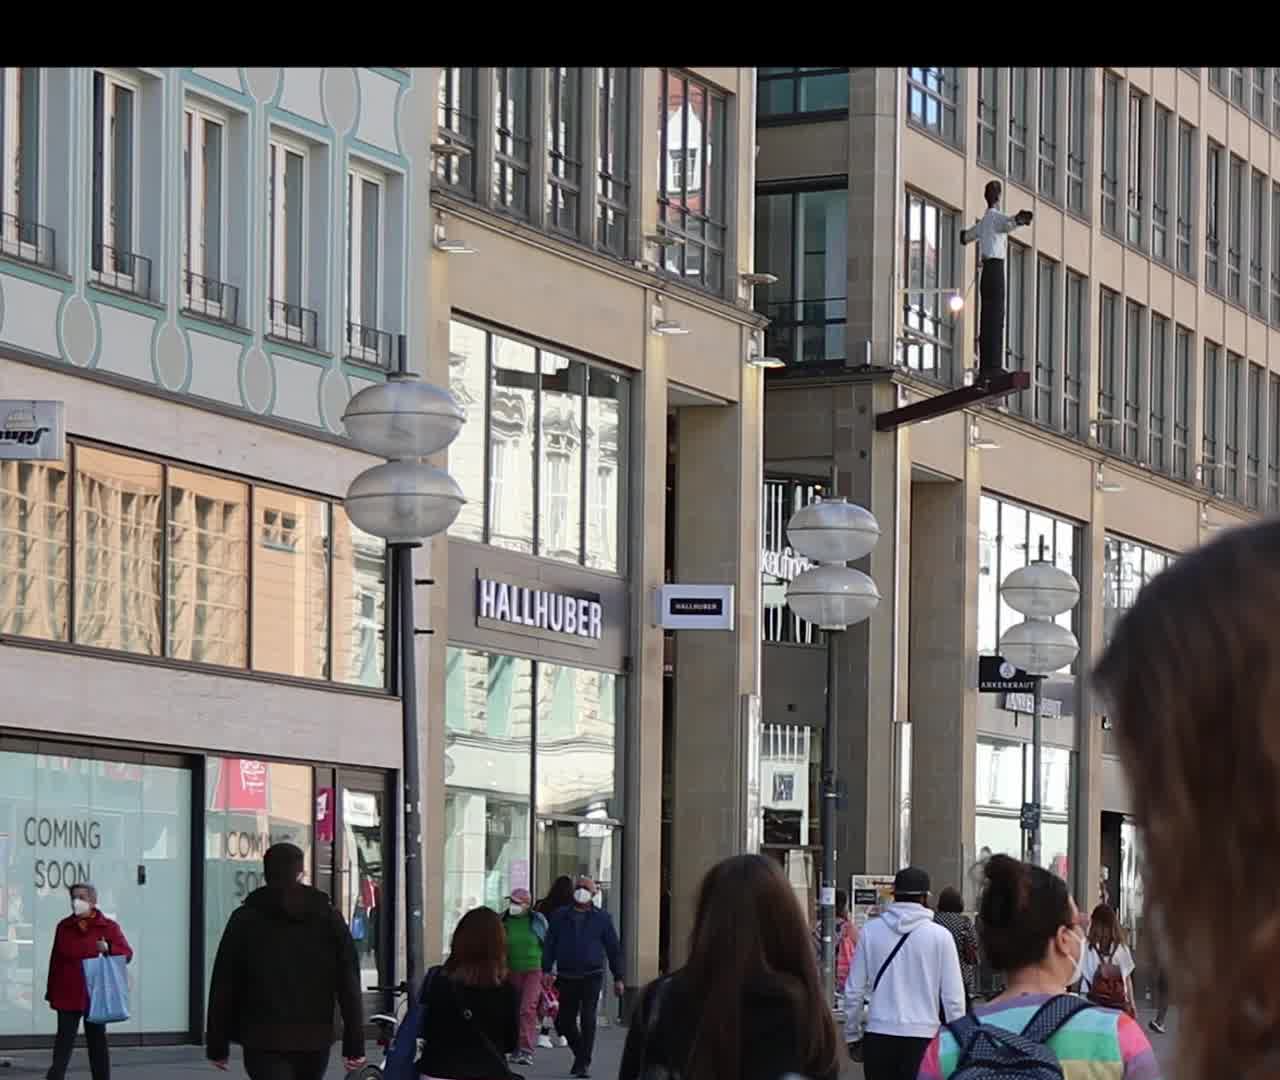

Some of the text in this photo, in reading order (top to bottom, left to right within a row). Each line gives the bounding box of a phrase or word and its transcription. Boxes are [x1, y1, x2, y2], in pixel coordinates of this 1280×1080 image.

[479, 578, 603, 640] HALLHUBER
[674, 602, 718, 611] HALLHUBER
[24, 815, 102, 850] COMING
[34, 859, 91, 889] SOON
